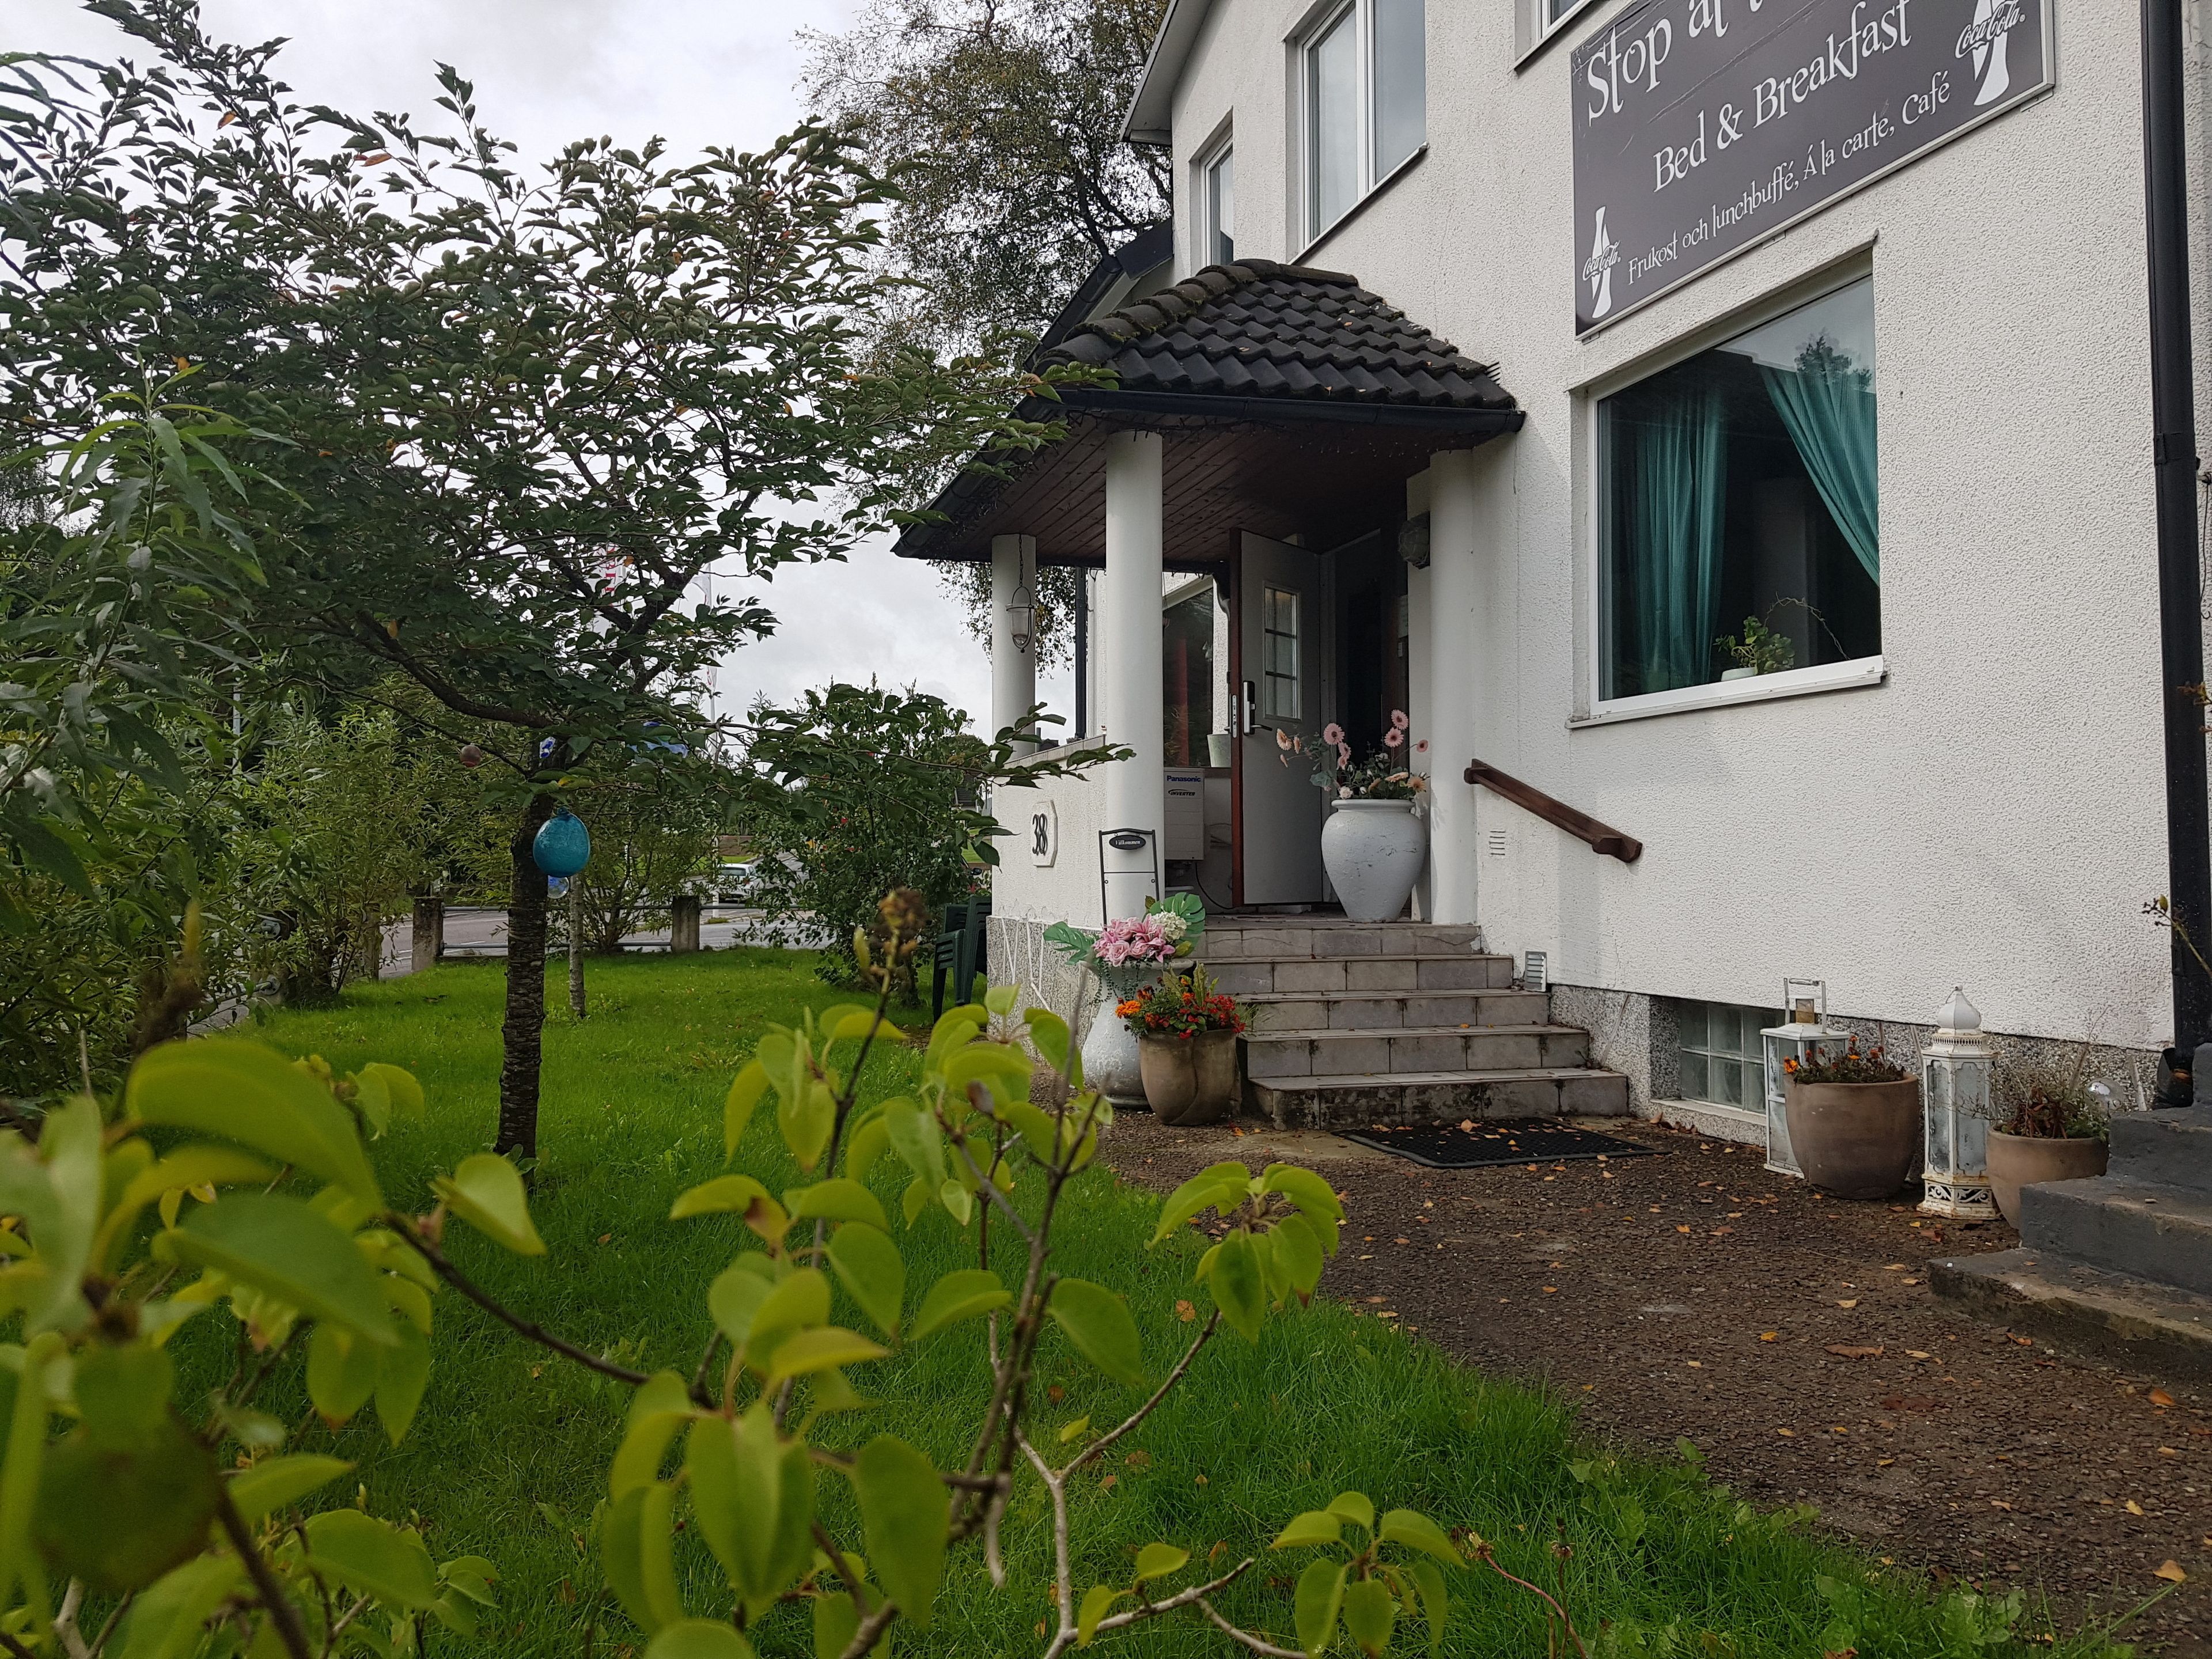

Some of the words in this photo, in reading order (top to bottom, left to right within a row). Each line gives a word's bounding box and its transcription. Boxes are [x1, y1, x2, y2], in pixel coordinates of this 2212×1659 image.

[1587, 18, 1672, 127] Stop
[1653, 110, 1707, 192] Bed
[1717, 103, 1743, 149] &
[1752, 0, 1912, 129] Breakfast
[1628, 229, 1679, 285] Frukost
[1682, 217, 1709, 249] och
[1712, 160, 1800, 237] lunchbuffé,
[1820, 139, 1836, 175] la
[1842, 111, 1895, 160] carte,
[1902, 70, 1951, 124] Café
[1032, 813, 1048, 856] 38
